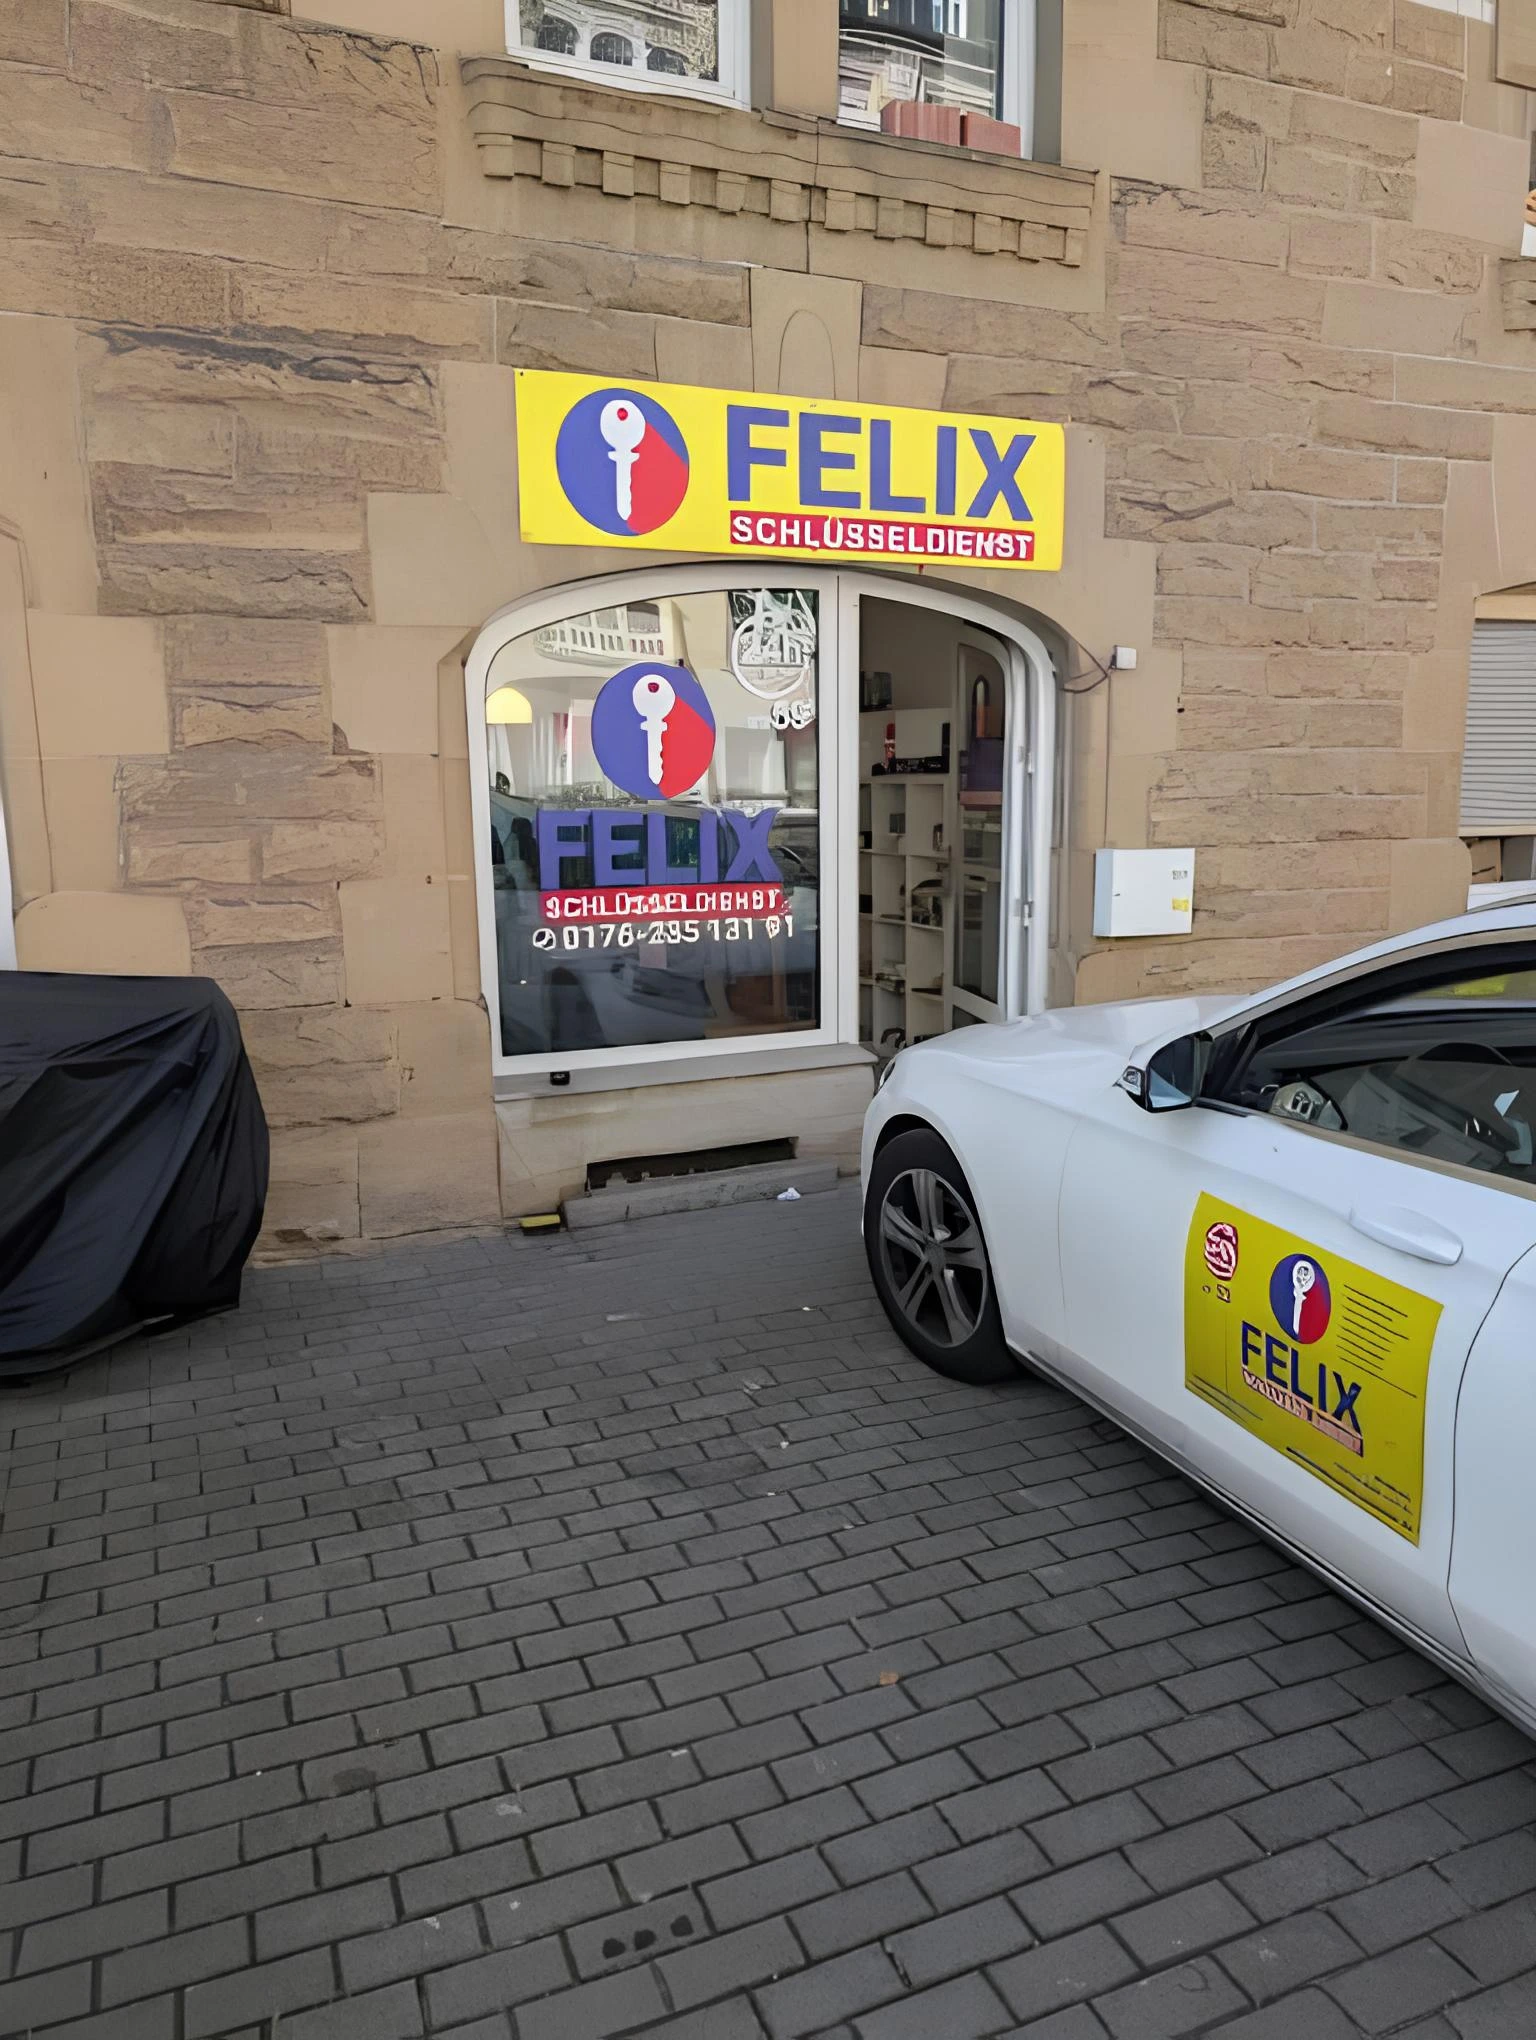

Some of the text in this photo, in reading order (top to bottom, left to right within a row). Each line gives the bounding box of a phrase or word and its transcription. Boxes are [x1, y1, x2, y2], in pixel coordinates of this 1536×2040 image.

[727, 404, 1036, 521] FELIX
[732, 515, 1033, 560] SCHLÜSSELDIENST
[537, 807, 783, 890] FELIX
[1242, 1320, 1362, 1437] FELIX
